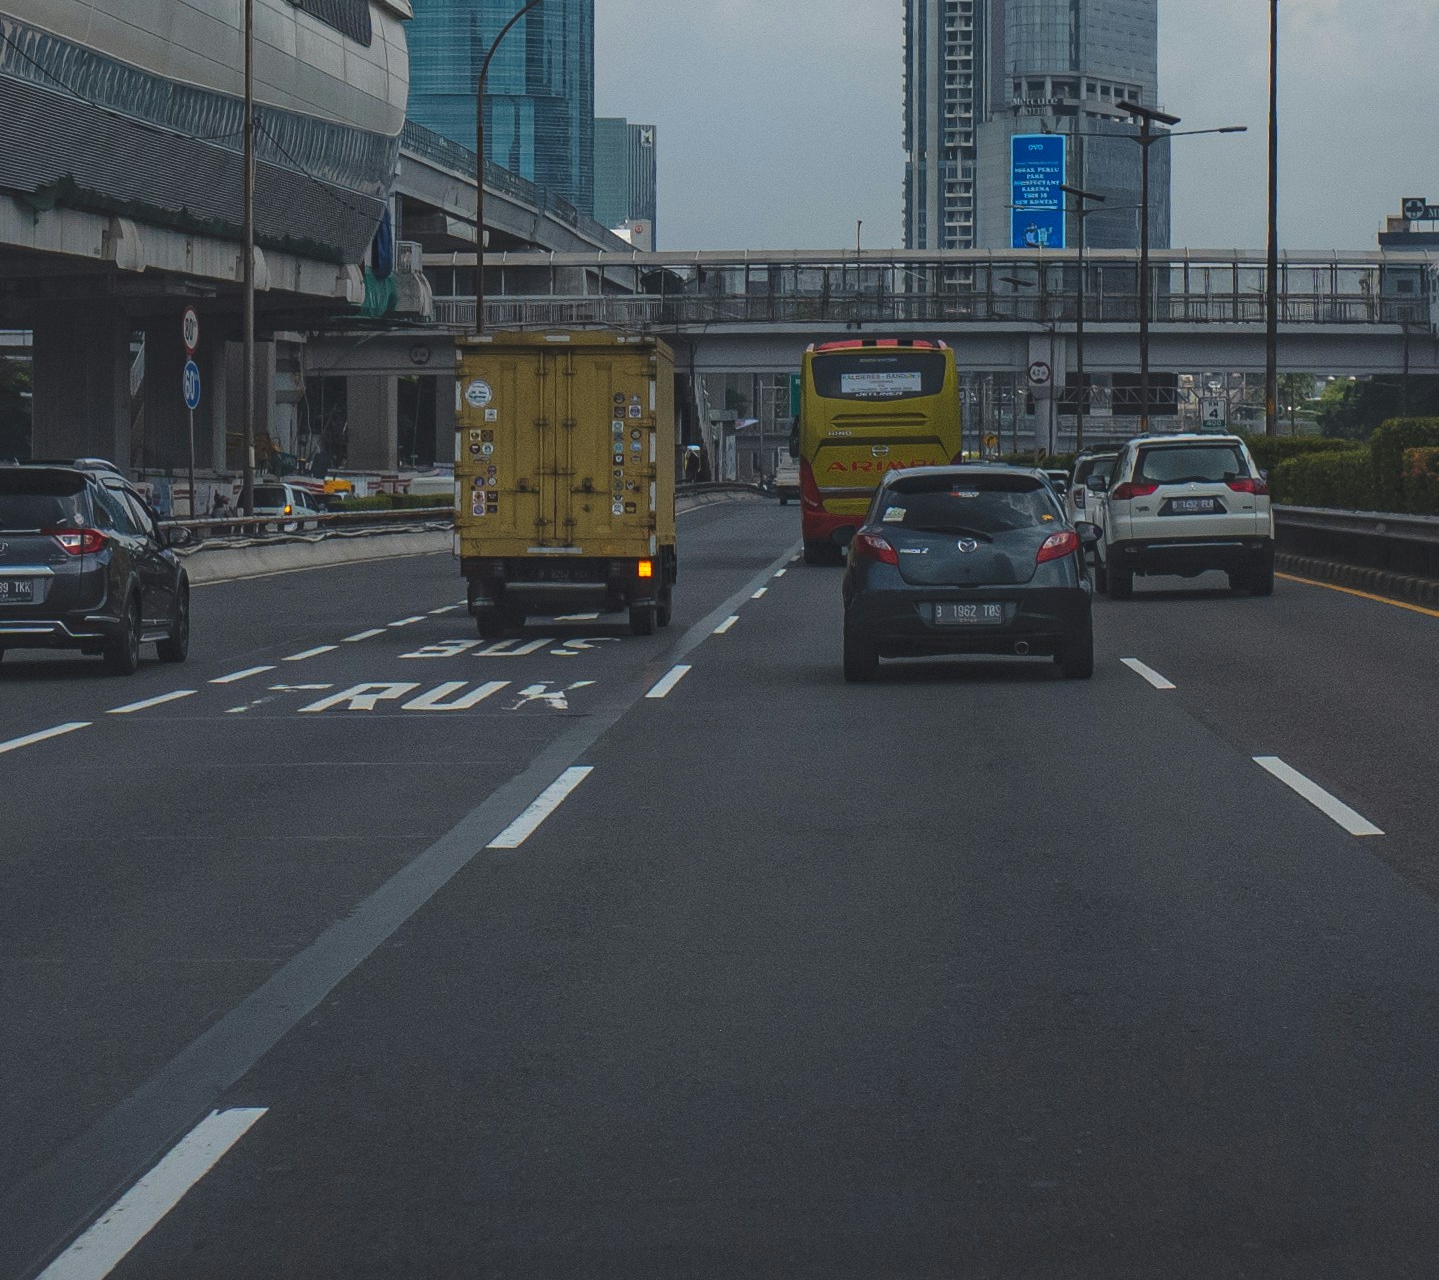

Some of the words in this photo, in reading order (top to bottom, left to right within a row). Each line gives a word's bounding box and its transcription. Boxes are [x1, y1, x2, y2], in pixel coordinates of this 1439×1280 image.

[185, 369, 195, 401] 60
[1209, 408, 1219, 419] 4
[935, 604, 942, 618] B
[953, 604, 977, 617] 1962
